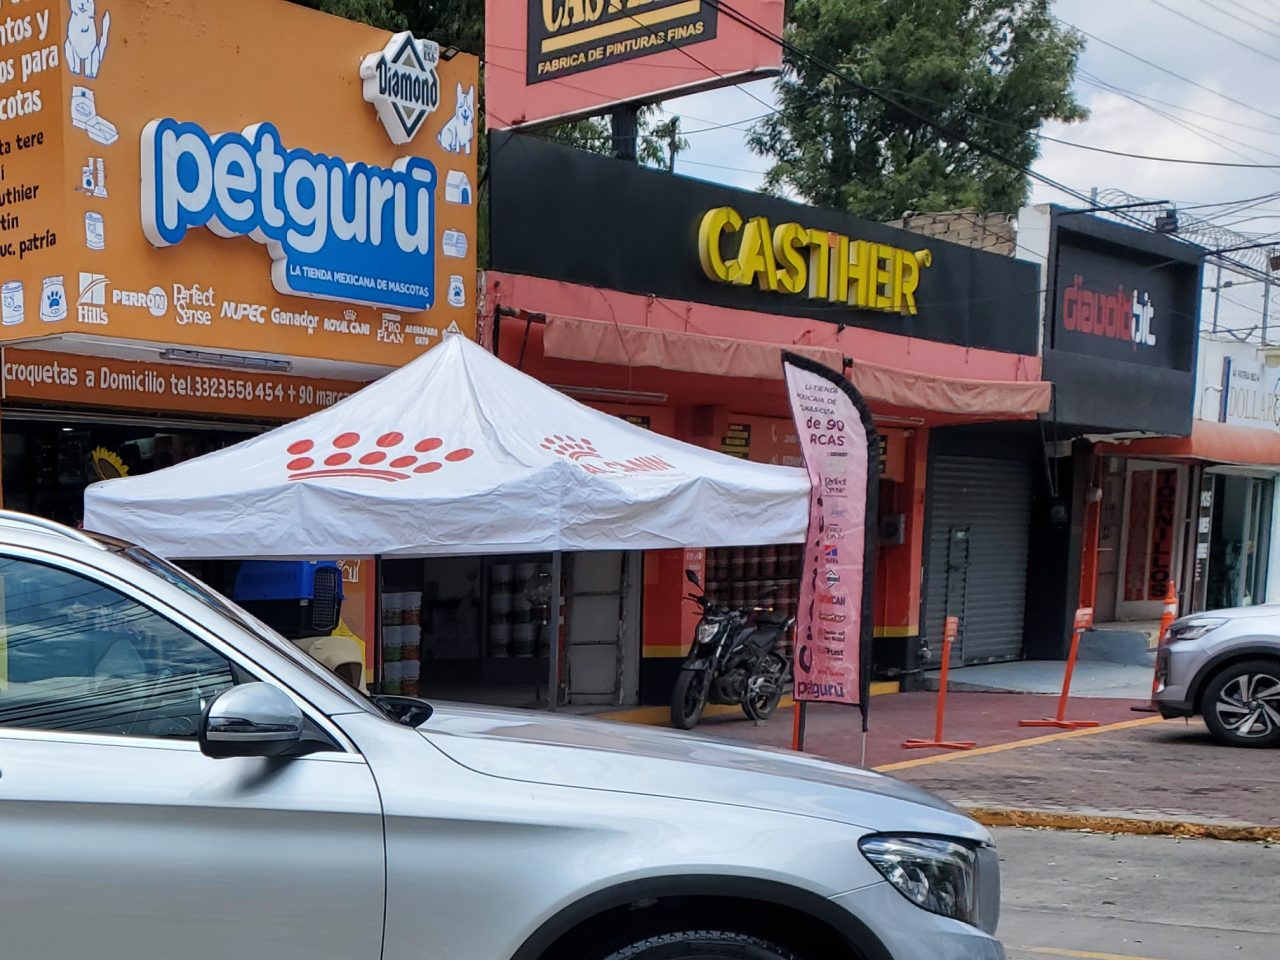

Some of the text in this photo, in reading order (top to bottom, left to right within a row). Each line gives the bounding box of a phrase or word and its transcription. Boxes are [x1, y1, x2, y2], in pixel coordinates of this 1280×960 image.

[36, 9, 49, 41] y
[536, 21, 704, 75] FABRICA DE PINTURAS FINAS
[21, 44, 59, 83] para
[376, 57, 438, 111] Diamond
[16, 131, 44, 151] tere
[698, 206, 920, 317] CASTHER
[290, 264, 430, 298] LA TIENDA MEXICANA DE MASCOTAS
[173, 284, 216, 308] Perfect
[77, 305, 109, 325] Hill's
[176, 302, 212, 326] Sense
[220, 300, 267, 324] NUPEC
[270, 307, 320, 329] Ganador
[323, 318, 349, 334] ROYAL
[376, 329, 404, 344] PLAN
[381, 319, 401, 333] PRO
[4, 361, 78, 388] croquetas
[86, 371, 95, 388] a
[100, 366, 166, 395] Domicilio
[299, 385, 314, 405] 90
[806, 415, 845, 431] de 90
